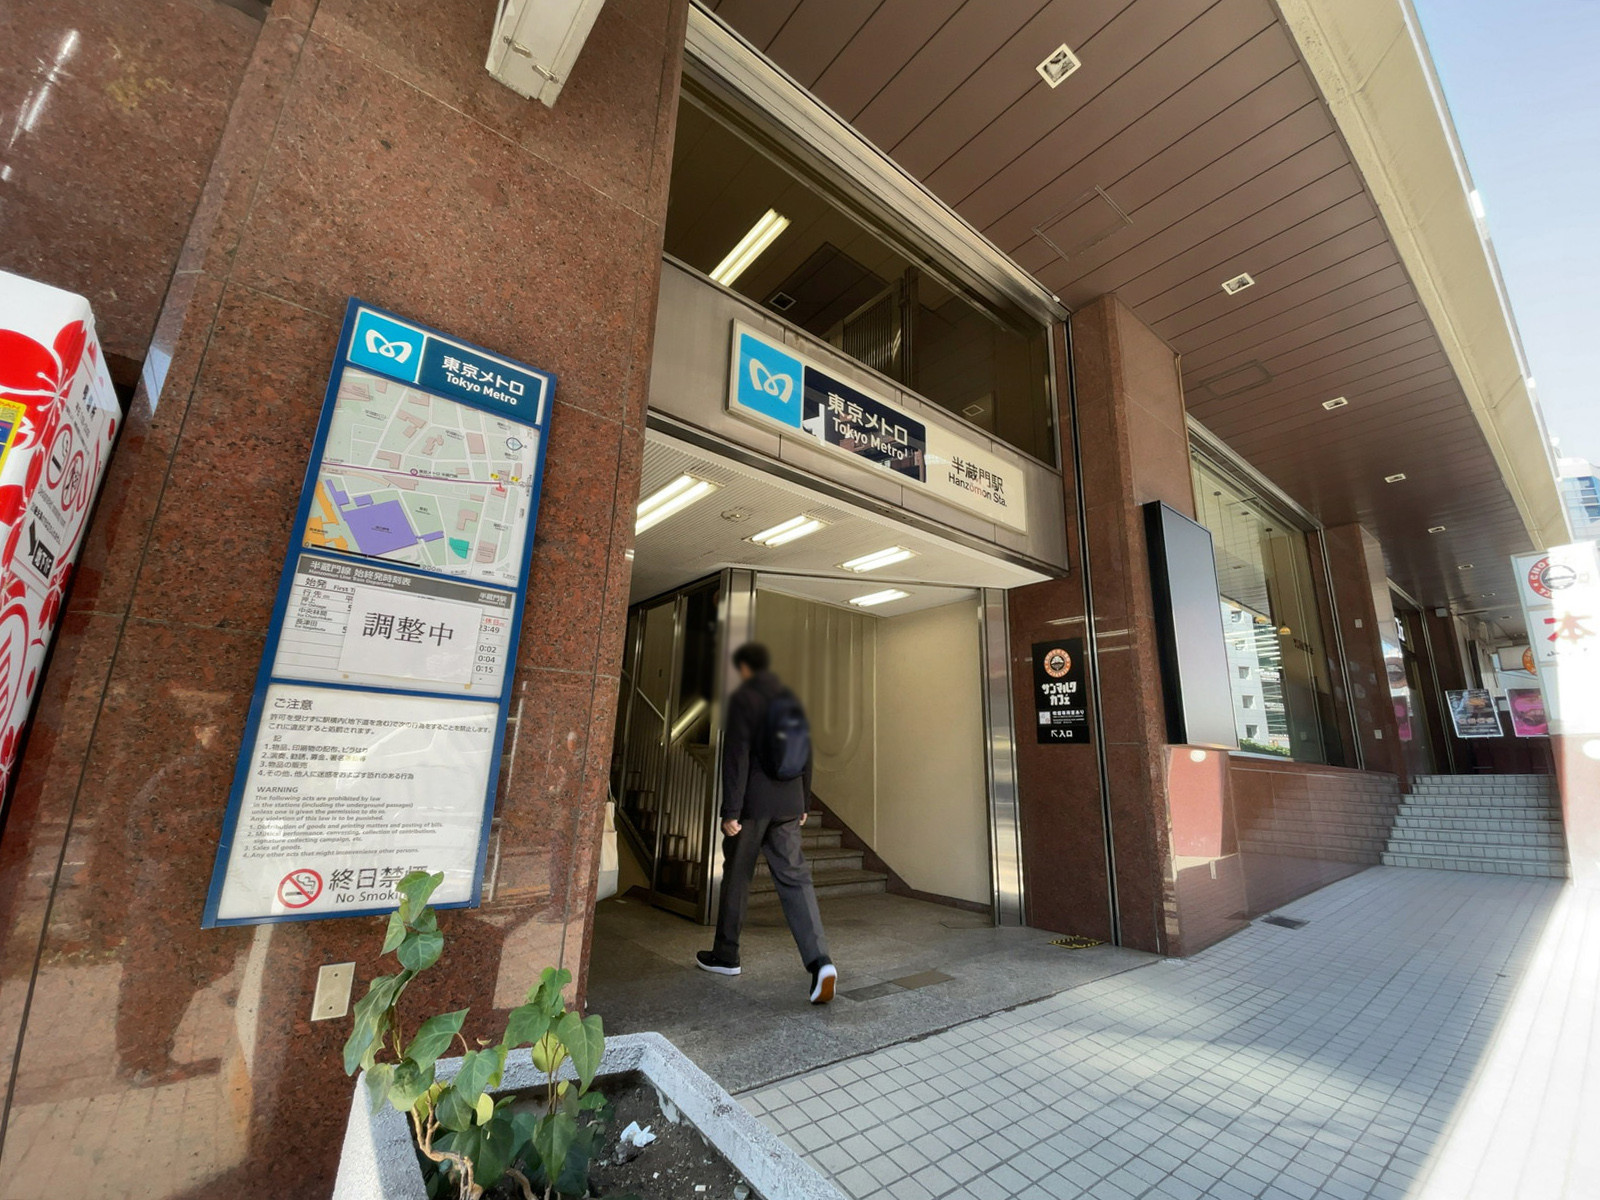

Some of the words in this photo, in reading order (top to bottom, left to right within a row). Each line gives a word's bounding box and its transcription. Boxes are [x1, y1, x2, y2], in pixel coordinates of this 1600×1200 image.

[442, 355, 525, 396] 東京メトロ
[446, 372, 481, 393] Tokyo
[483, 385, 517, 406] Metro
[827, 391, 908, 446] 東京メトロ
[832, 417, 868, 444] Tokyo
[871, 434, 904, 461] Metro
[951, 455, 1005, 495] 半蔵門駅
[305, 577, 327, 589] 始発
[333, 584, 349, 593] First
[362, 612, 454, 647] 調整中
[479, 644, 497, 653] 0:02
[478, 655, 495, 664] 0:04
[475, 664, 493, 674] 0:15
[1041, 681, 1077, 695] サンマルク
[274, 697, 313, 711] ご注意
[1050, 694, 1071, 706] カフェ
[328, 865, 428, 891] 終日禁
[336, 893, 354, 903] No
[359, 889, 400, 902] Smoki
